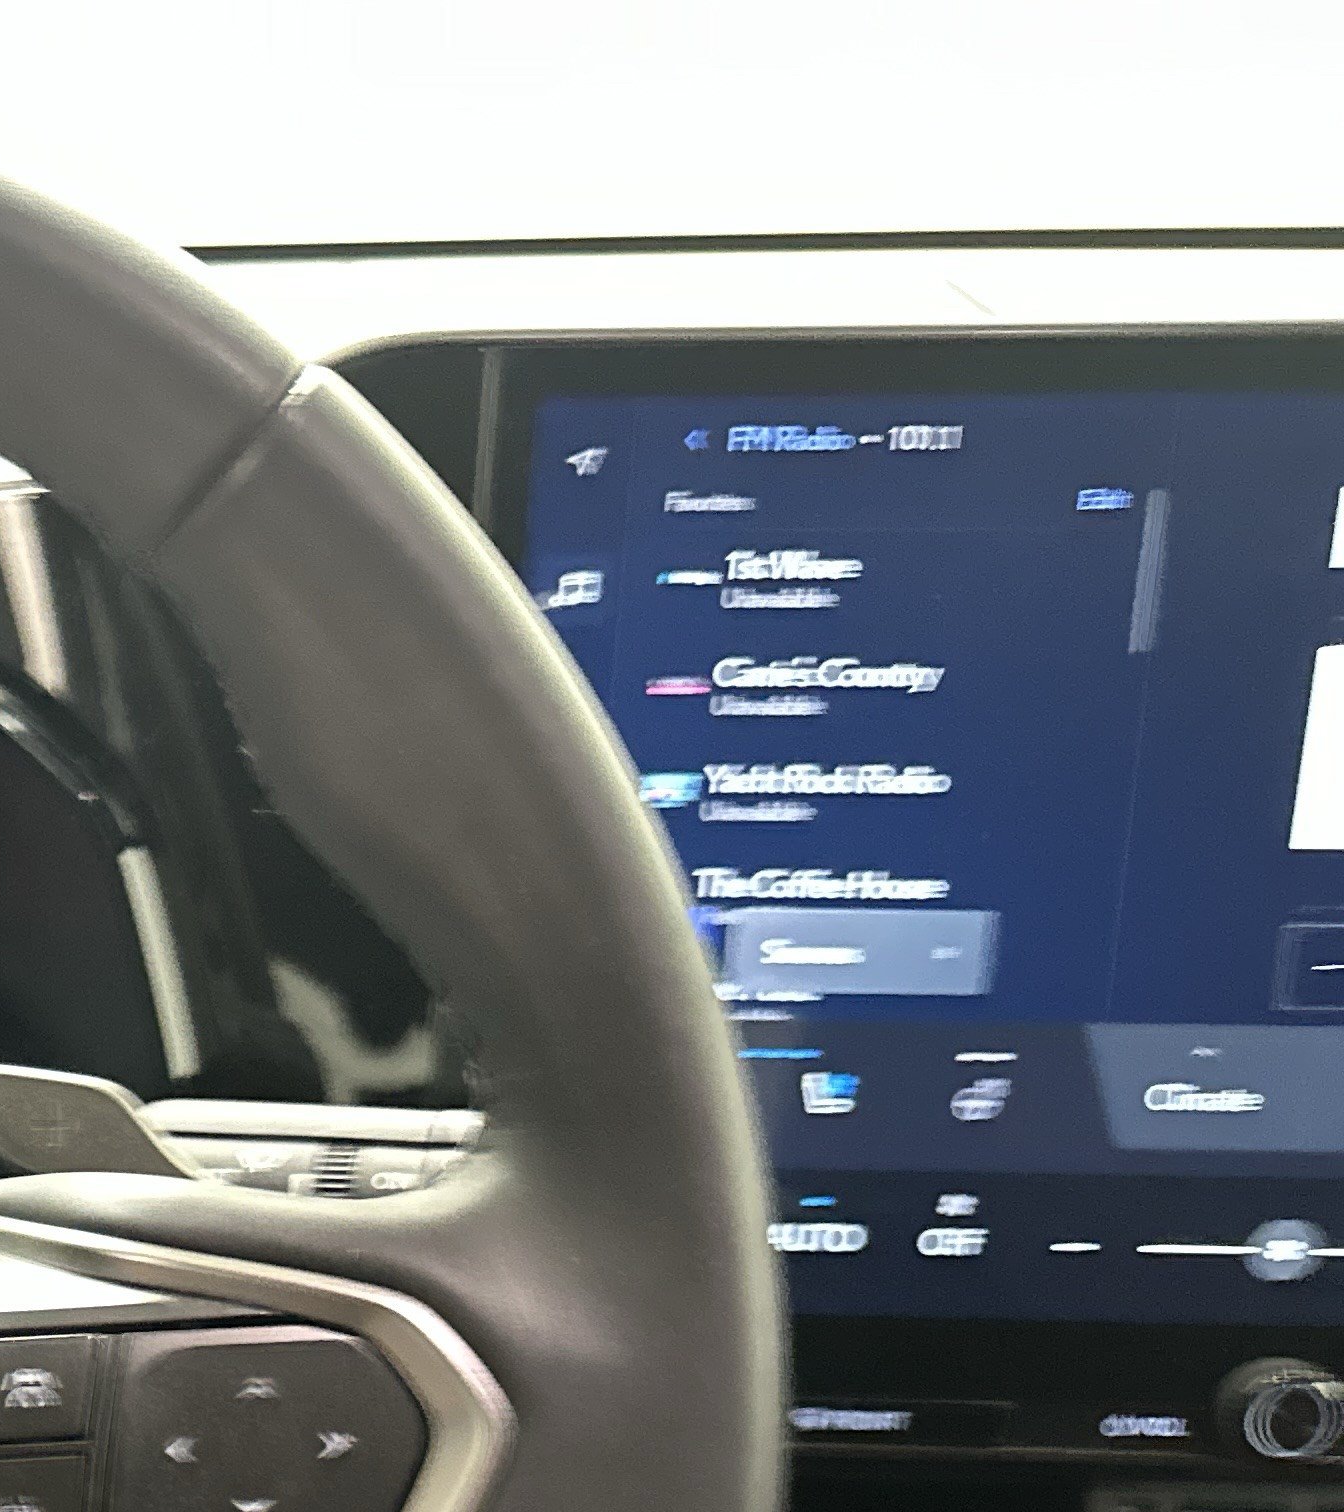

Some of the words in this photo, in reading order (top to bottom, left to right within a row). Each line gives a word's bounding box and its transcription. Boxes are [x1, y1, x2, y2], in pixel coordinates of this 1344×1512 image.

[728, 425, 776, 451] FM
[774, 425, 857, 451] Radio
[768, 550, 863, 580] Wave
[818, 657, 945, 694] Country
[703, 764, 784, 794] Yacht
[782, 764, 858, 794] Rock
[856, 765, 952, 794] Radio
[692, 868, 752, 898] The
[749, 869, 848, 898] Coffee
[845, 870, 951, 899] House
